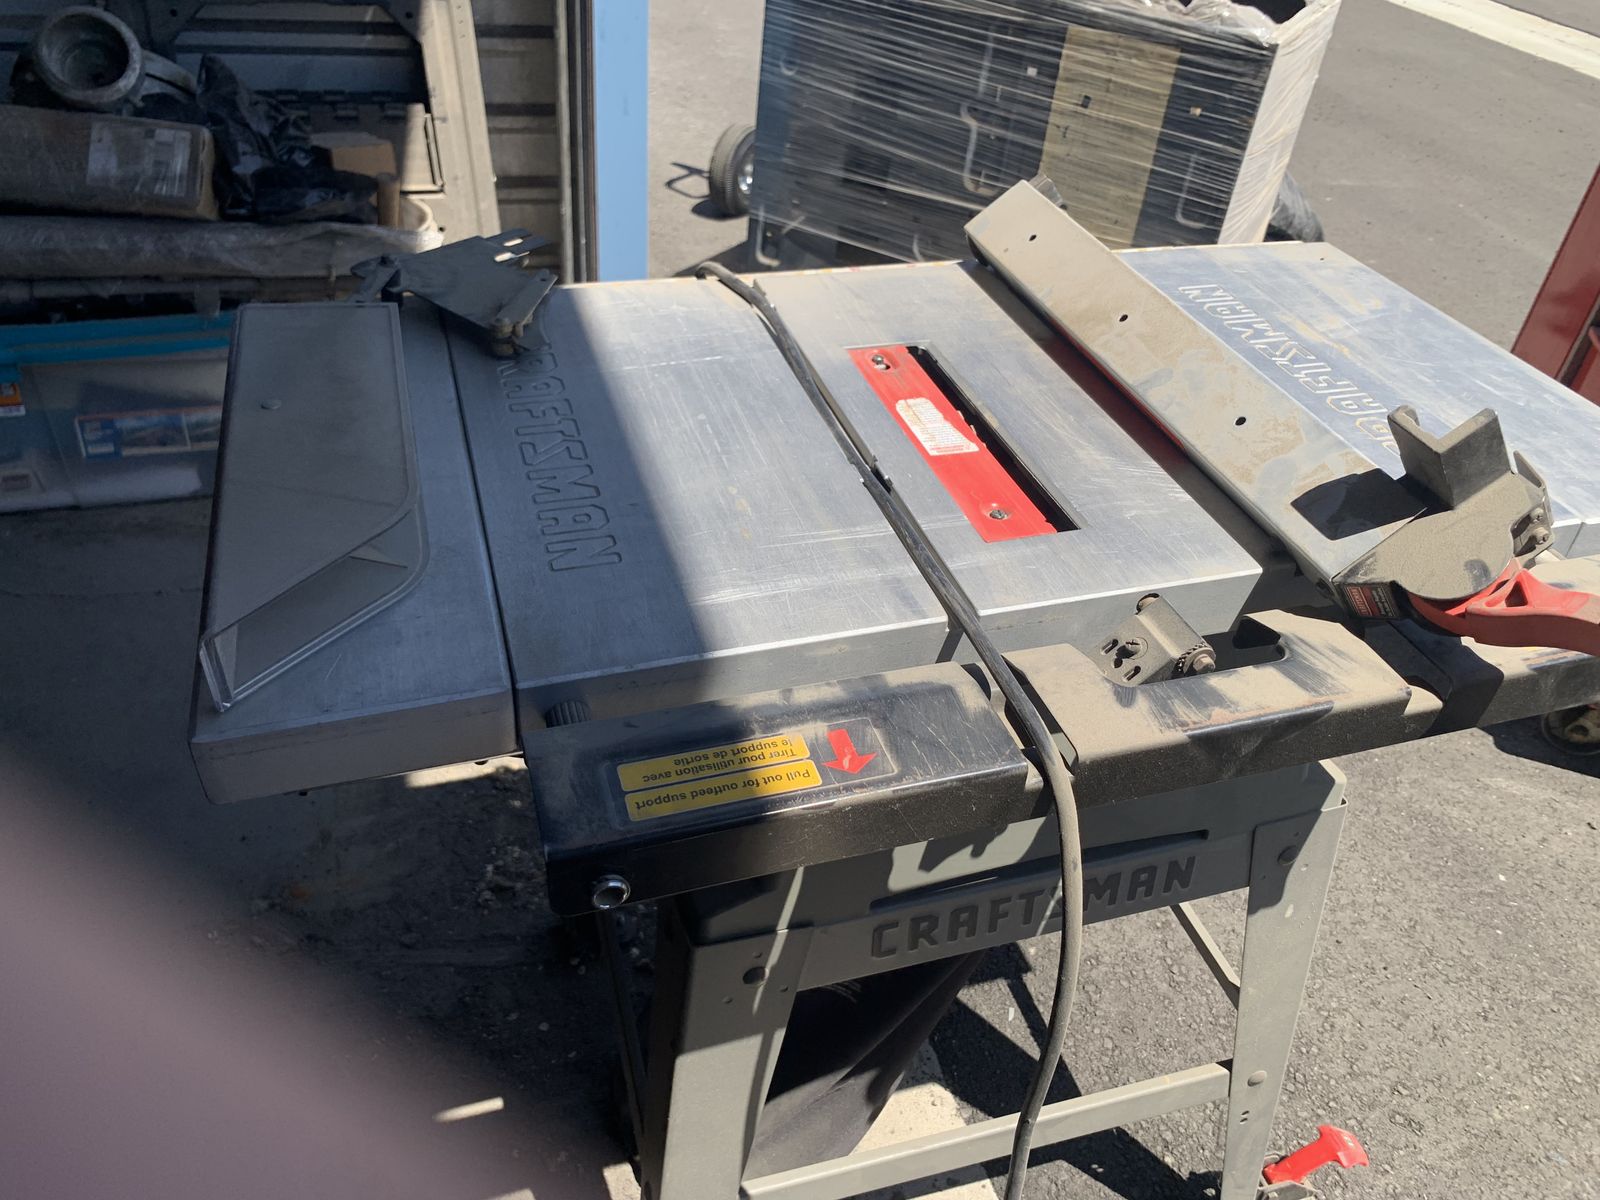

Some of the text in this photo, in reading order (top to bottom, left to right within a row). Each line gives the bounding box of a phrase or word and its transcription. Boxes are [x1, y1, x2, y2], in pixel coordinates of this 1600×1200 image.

[1178, 284, 1402, 457] RAFTSMAN
[497, 325, 622, 571] RAFTSMAN
[642, 748, 796, 783] Tirer pour utilisation avec
[674, 753, 709, 766] sortie
[714, 750, 729, 759] de
[732, 742, 778, 756] support
[635, 769, 811, 810] Pull out for outfeed support
